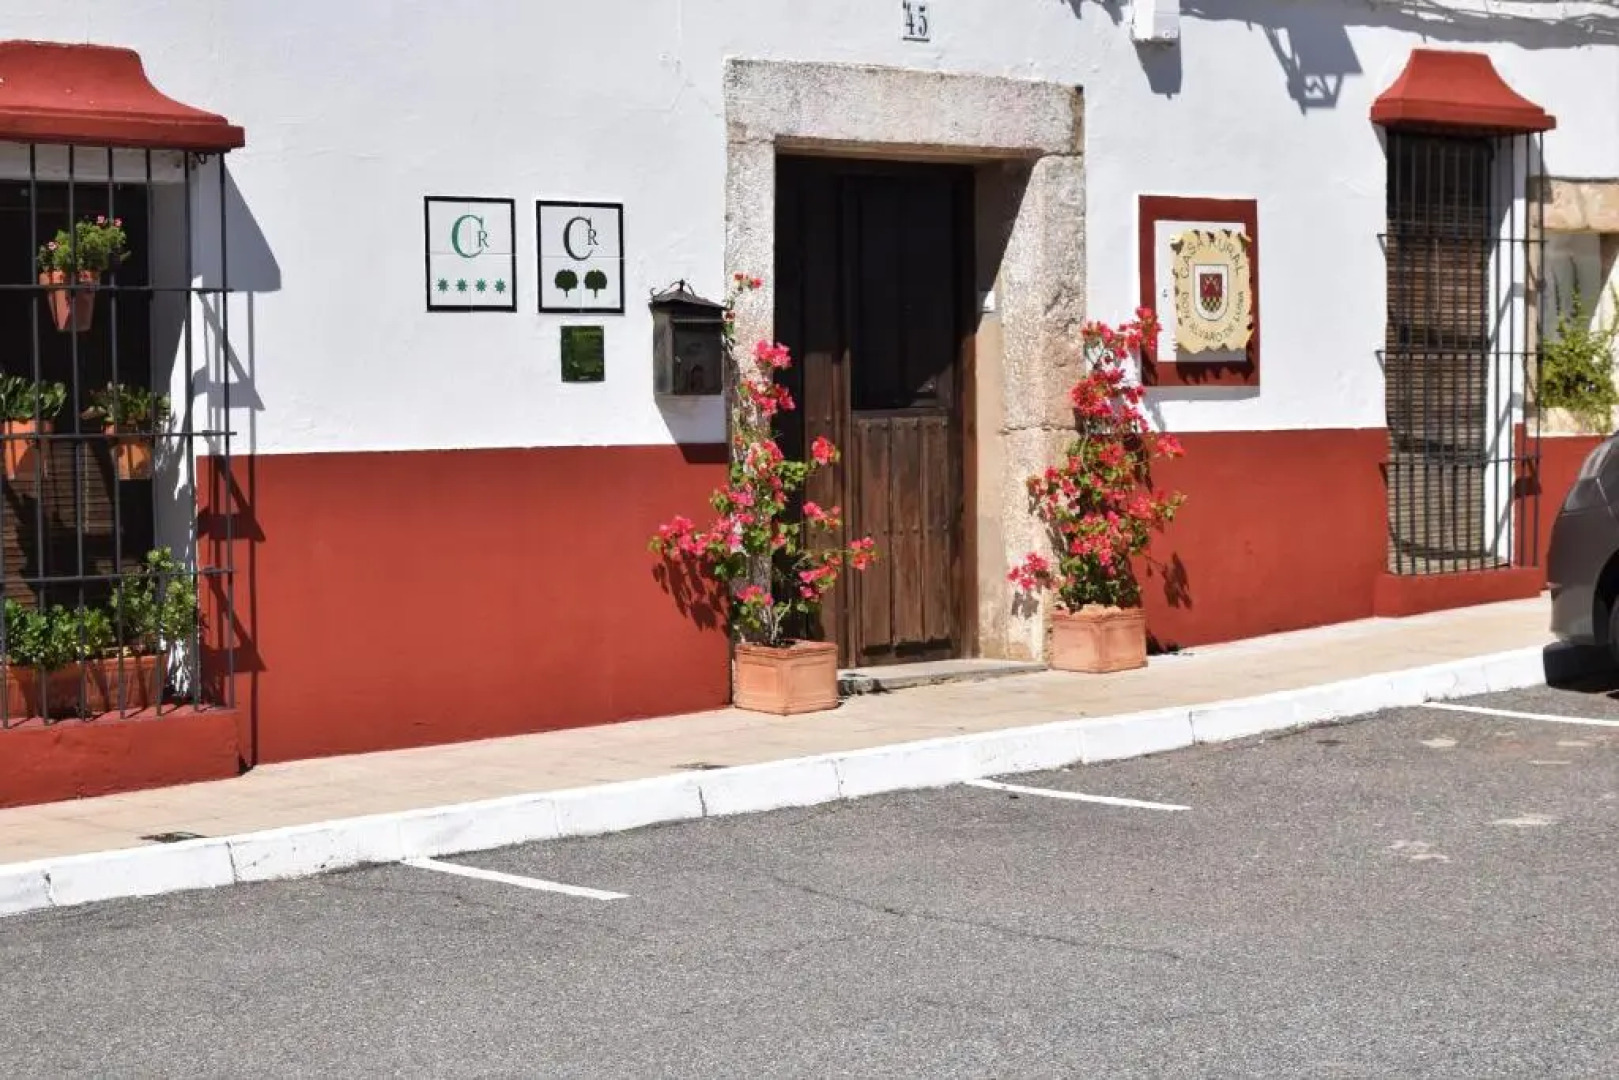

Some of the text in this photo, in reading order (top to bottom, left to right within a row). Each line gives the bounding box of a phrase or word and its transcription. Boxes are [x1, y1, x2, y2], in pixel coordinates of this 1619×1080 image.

[905, 2, 928, 37] 45
[1180, 238, 1245, 279] CASA RURAL
